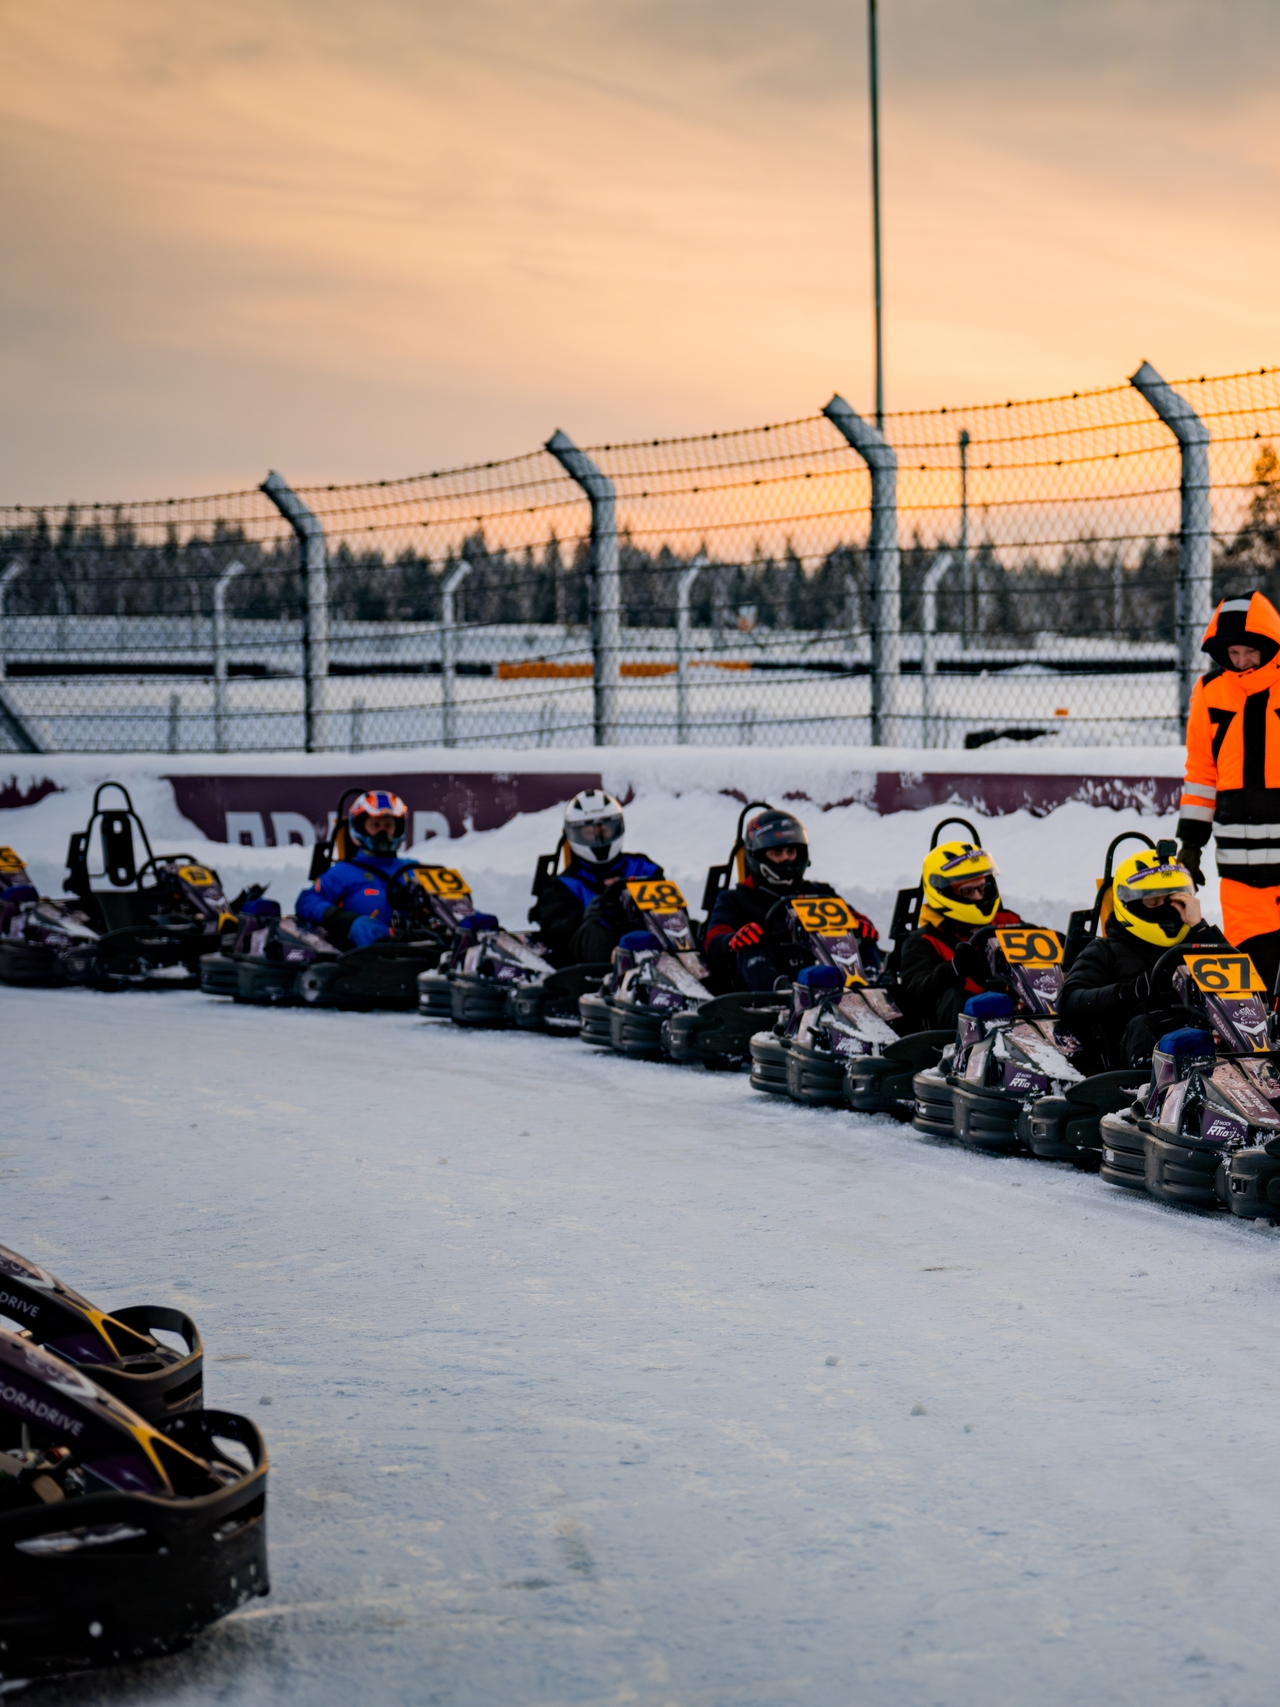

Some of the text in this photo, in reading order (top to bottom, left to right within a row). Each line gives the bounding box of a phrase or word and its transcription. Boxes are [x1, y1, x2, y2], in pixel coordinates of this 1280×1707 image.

[418, 871, 463, 892] 19
[636, 885, 684, 906] 48
[795, 902, 848, 928] 39
[1002, 932, 1059, 961] 50
[1192, 957, 1251, 990] 67
